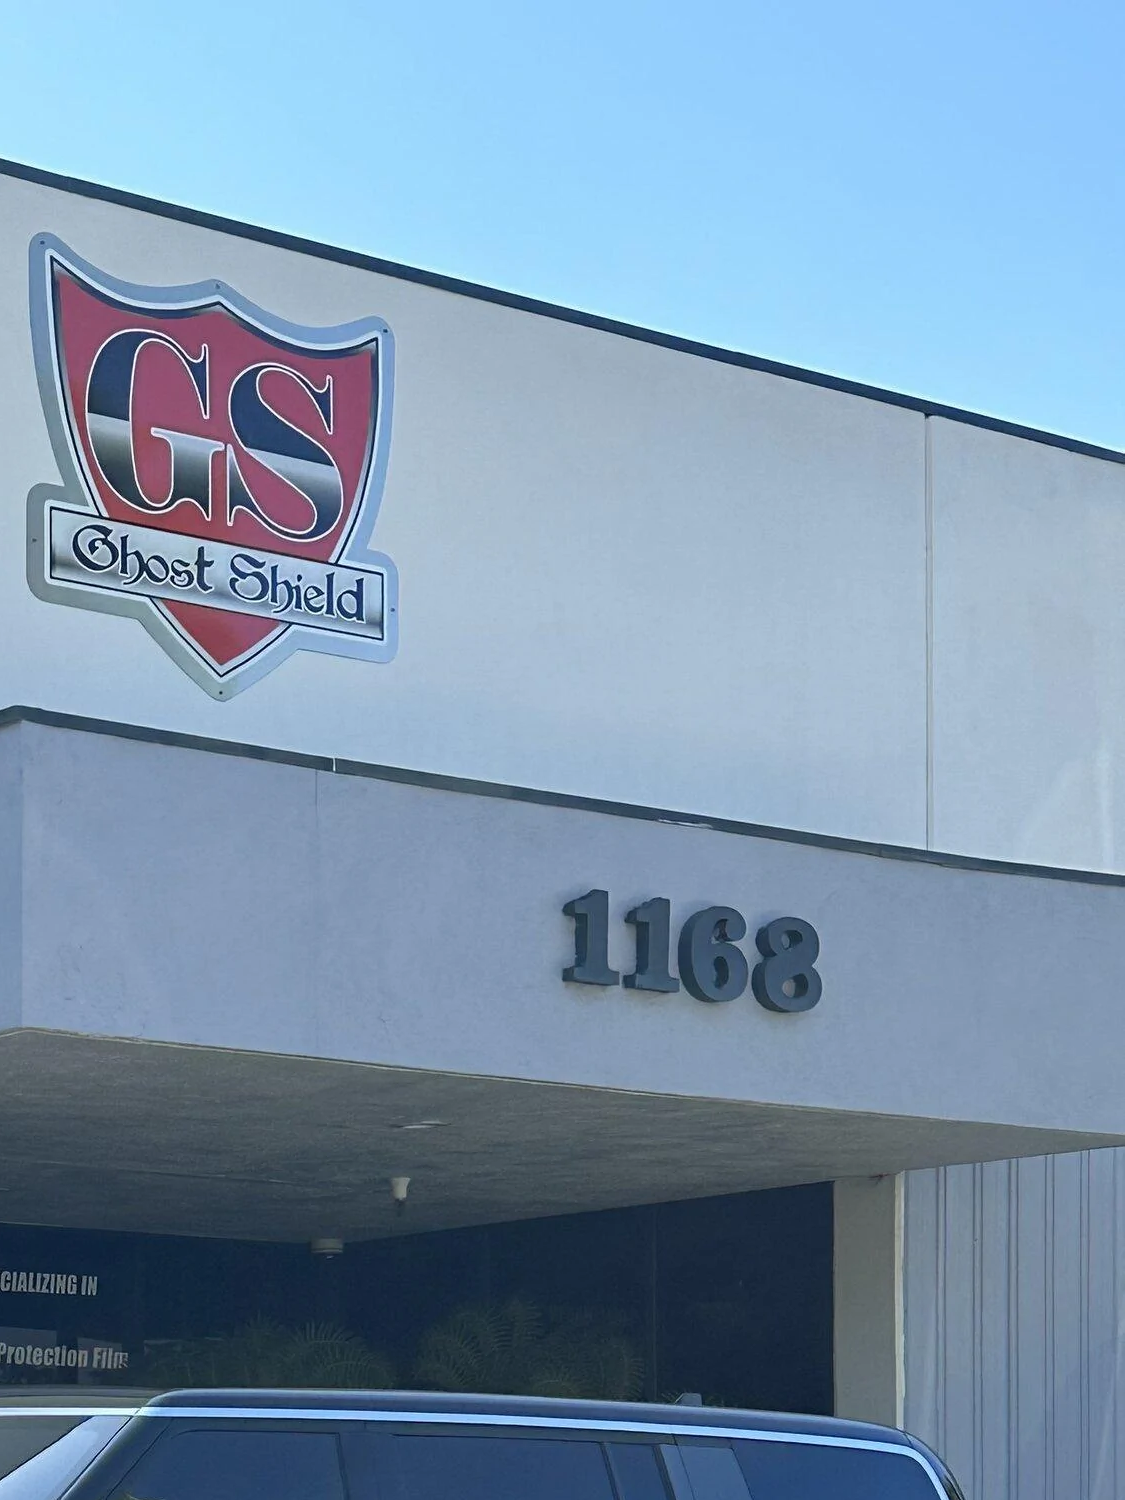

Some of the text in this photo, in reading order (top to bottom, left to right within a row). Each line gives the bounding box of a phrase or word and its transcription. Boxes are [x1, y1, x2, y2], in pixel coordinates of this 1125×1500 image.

[85, 328, 345, 542] GS
[72, 524, 366, 622] Ghost Shield
[561, 888, 823, 1013] 1168
[81, 1275, 98, 1296] IN
